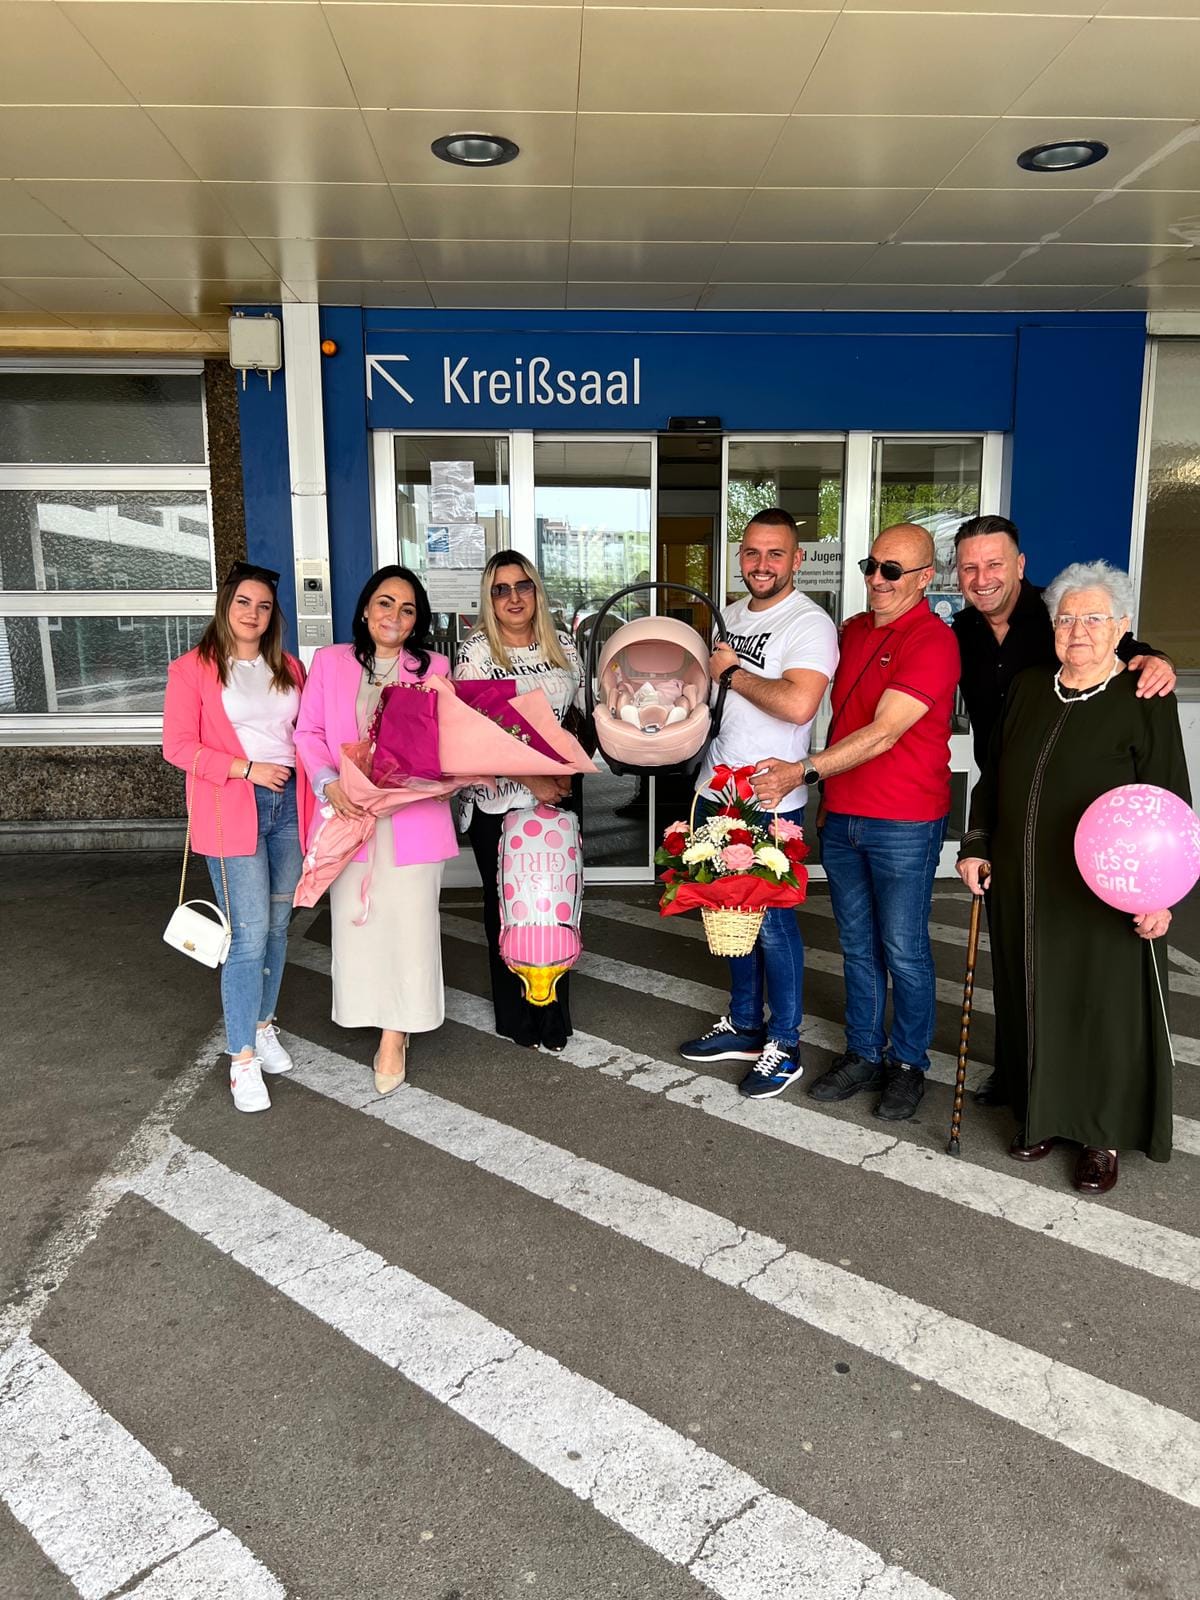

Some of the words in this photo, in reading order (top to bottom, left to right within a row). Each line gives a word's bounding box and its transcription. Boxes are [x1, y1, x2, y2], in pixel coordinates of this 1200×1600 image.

[443, 356, 640, 405] Kreißsaal
[797, 577, 818, 586] Eingang
[513, 852, 567, 873] GIRL
[513, 873, 528, 893] A
[1095, 873, 1142, 893] GIRL
